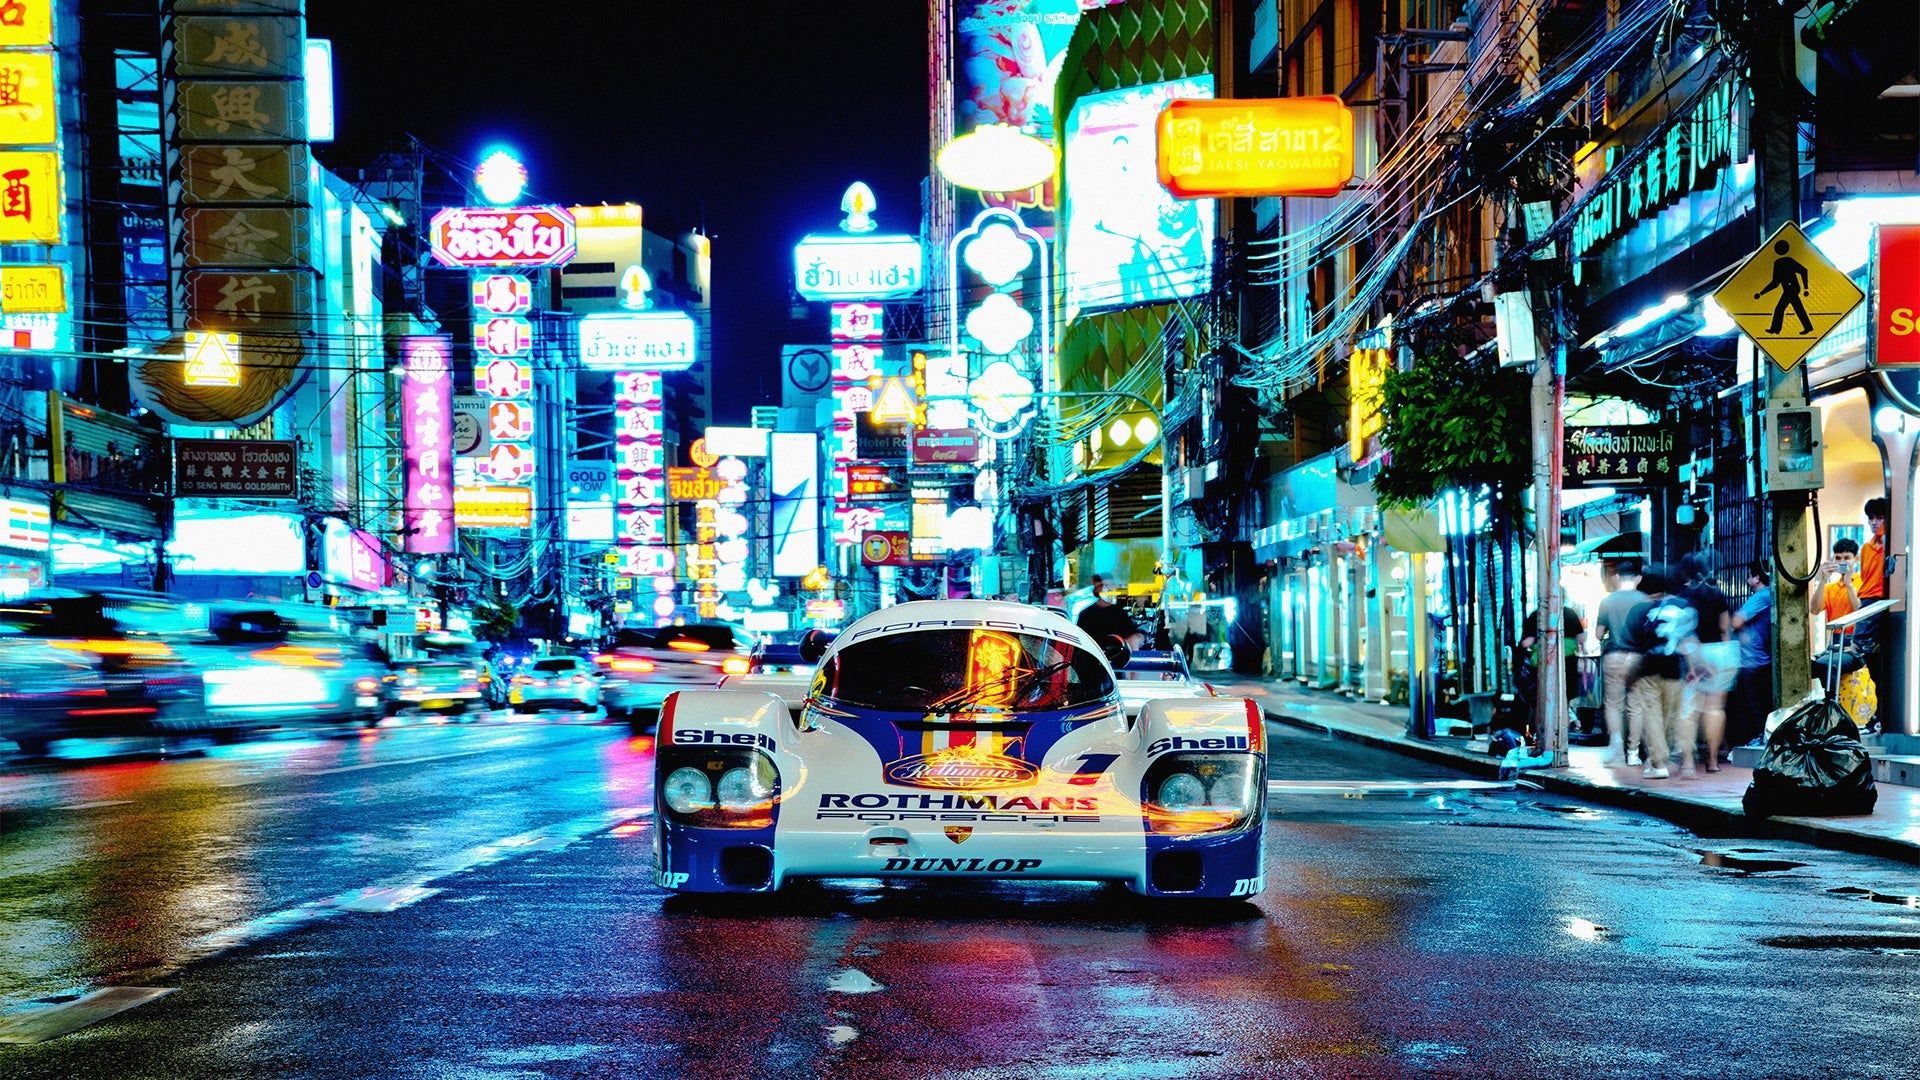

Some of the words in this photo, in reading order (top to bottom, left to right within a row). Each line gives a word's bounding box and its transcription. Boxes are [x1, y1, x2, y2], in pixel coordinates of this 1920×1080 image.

[203, 0, 278, 323] 成興大金行
[1208, 159, 1250, 172] JAESI
[1257, 156, 1342, 170] YAOWARAT
[1889, 307, 1920, 336] S
[858, 437, 888, 449] Hotel
[892, 436, 907, 449] Ro
[569, 471, 607, 482] GOLD
[183, 481, 193, 490] SO
[196, 481, 218, 490] SENG
[221, 481, 243, 490] HENG
[245, 482, 291, 491] GOLDSMITH
[577, 481, 603, 492] OW
[851, 620, 1082, 646] PORSCHE
[675, 729, 777, 754] Shell
[1147, 736, 1248, 759] Shell
[900, 761, 1020, 781] Rothmans
[1066, 753, 1121, 786] 1
[819, 793, 1100, 812] ROTHMANS
[816, 812, 1101, 823] PORSCHE
[879, 858, 1043, 873] DUNLOP
[657, 871, 690, 889] LOP
